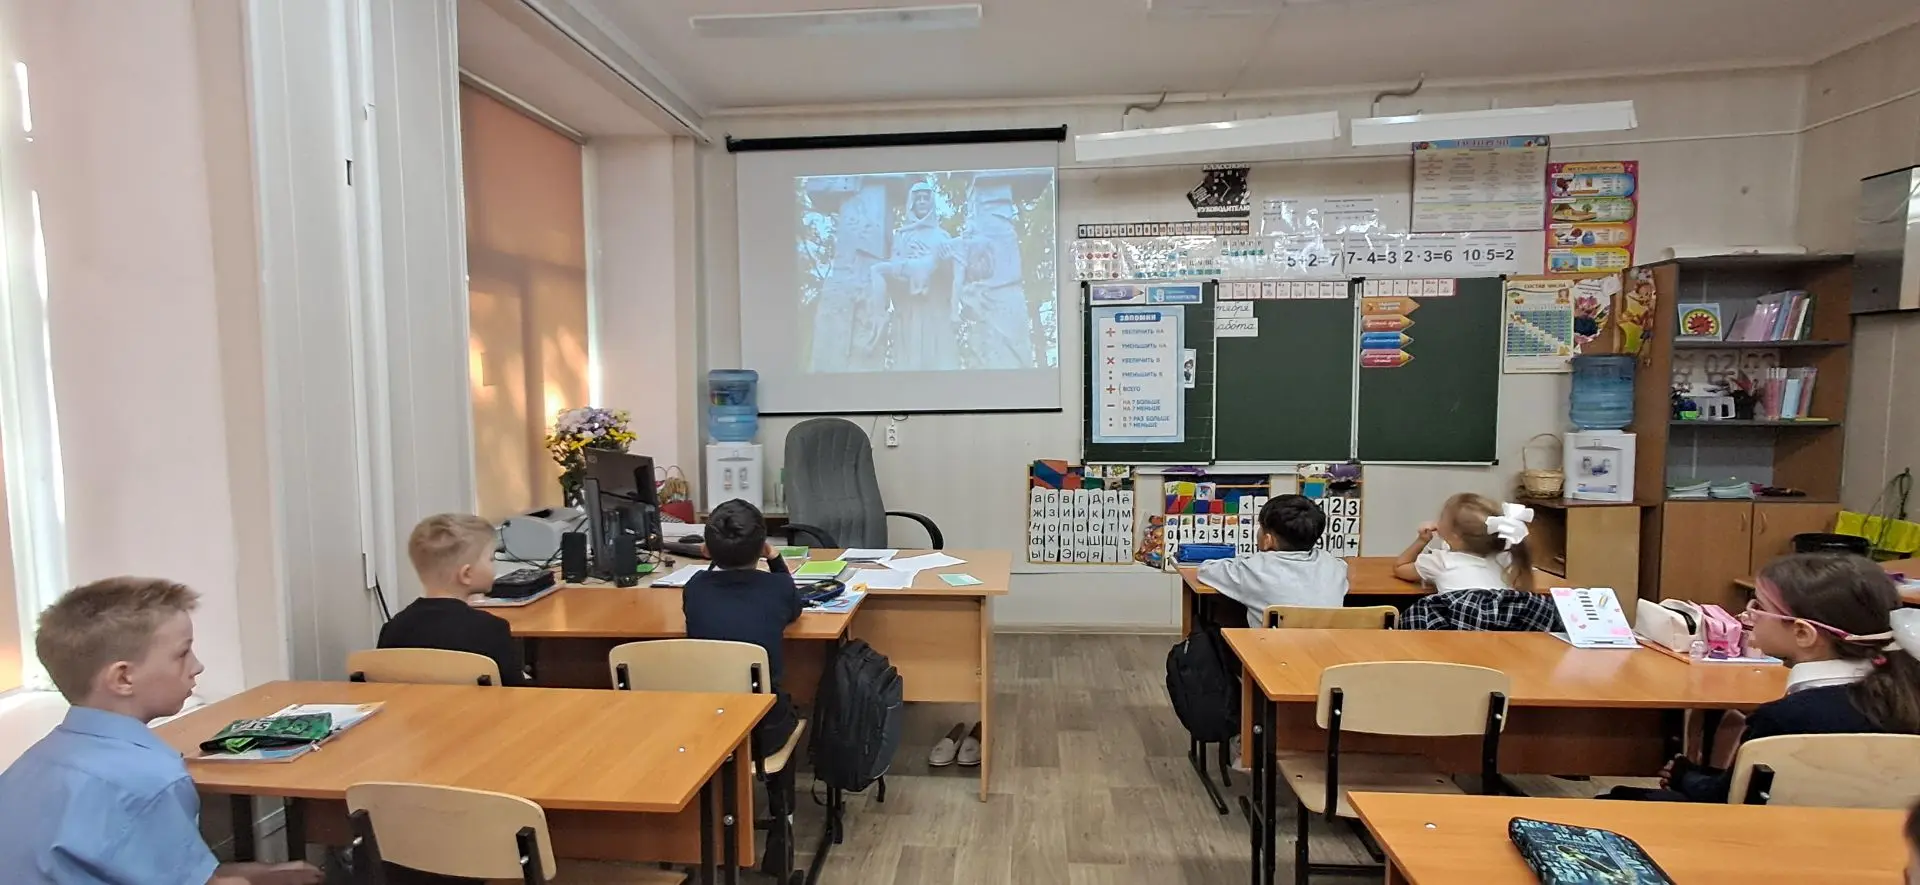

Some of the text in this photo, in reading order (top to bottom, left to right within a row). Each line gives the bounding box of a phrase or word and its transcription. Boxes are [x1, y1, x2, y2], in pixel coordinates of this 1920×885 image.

[1035, 495, 1042, 503] а
[1048, 494, 1055, 503] б
[1093, 494, 1102, 503] д
[1332, 499, 1341, 513] 2
[1348, 501, 1357, 515] 3
[1078, 507, 1085, 517] й
[1108, 509, 1115, 517] л
[1122, 510, 1130, 518] м
[1033, 523, 1040, 531] н
[1109, 523, 1115, 531] т
[1332, 518, 1356, 533] 6 7
[1168, 530, 1173, 539] 0
[1199, 530, 1205, 539] 2
[1212, 530, 1219, 538] 3
[1228, 530, 1234, 538] 4
[1243, 530, 1249, 538] 5
[1032, 537, 1042, 545] ф
[1331, 535, 1343, 549] 10
[1347, 539, 1357, 548] +
[1240, 544, 1251, 552] 12
[1032, 551, 1040, 559] ы
[1049, 551, 1054, 559] ь
[1077, 551, 1086, 559] ю
[1124, 550, 1127, 559] !
